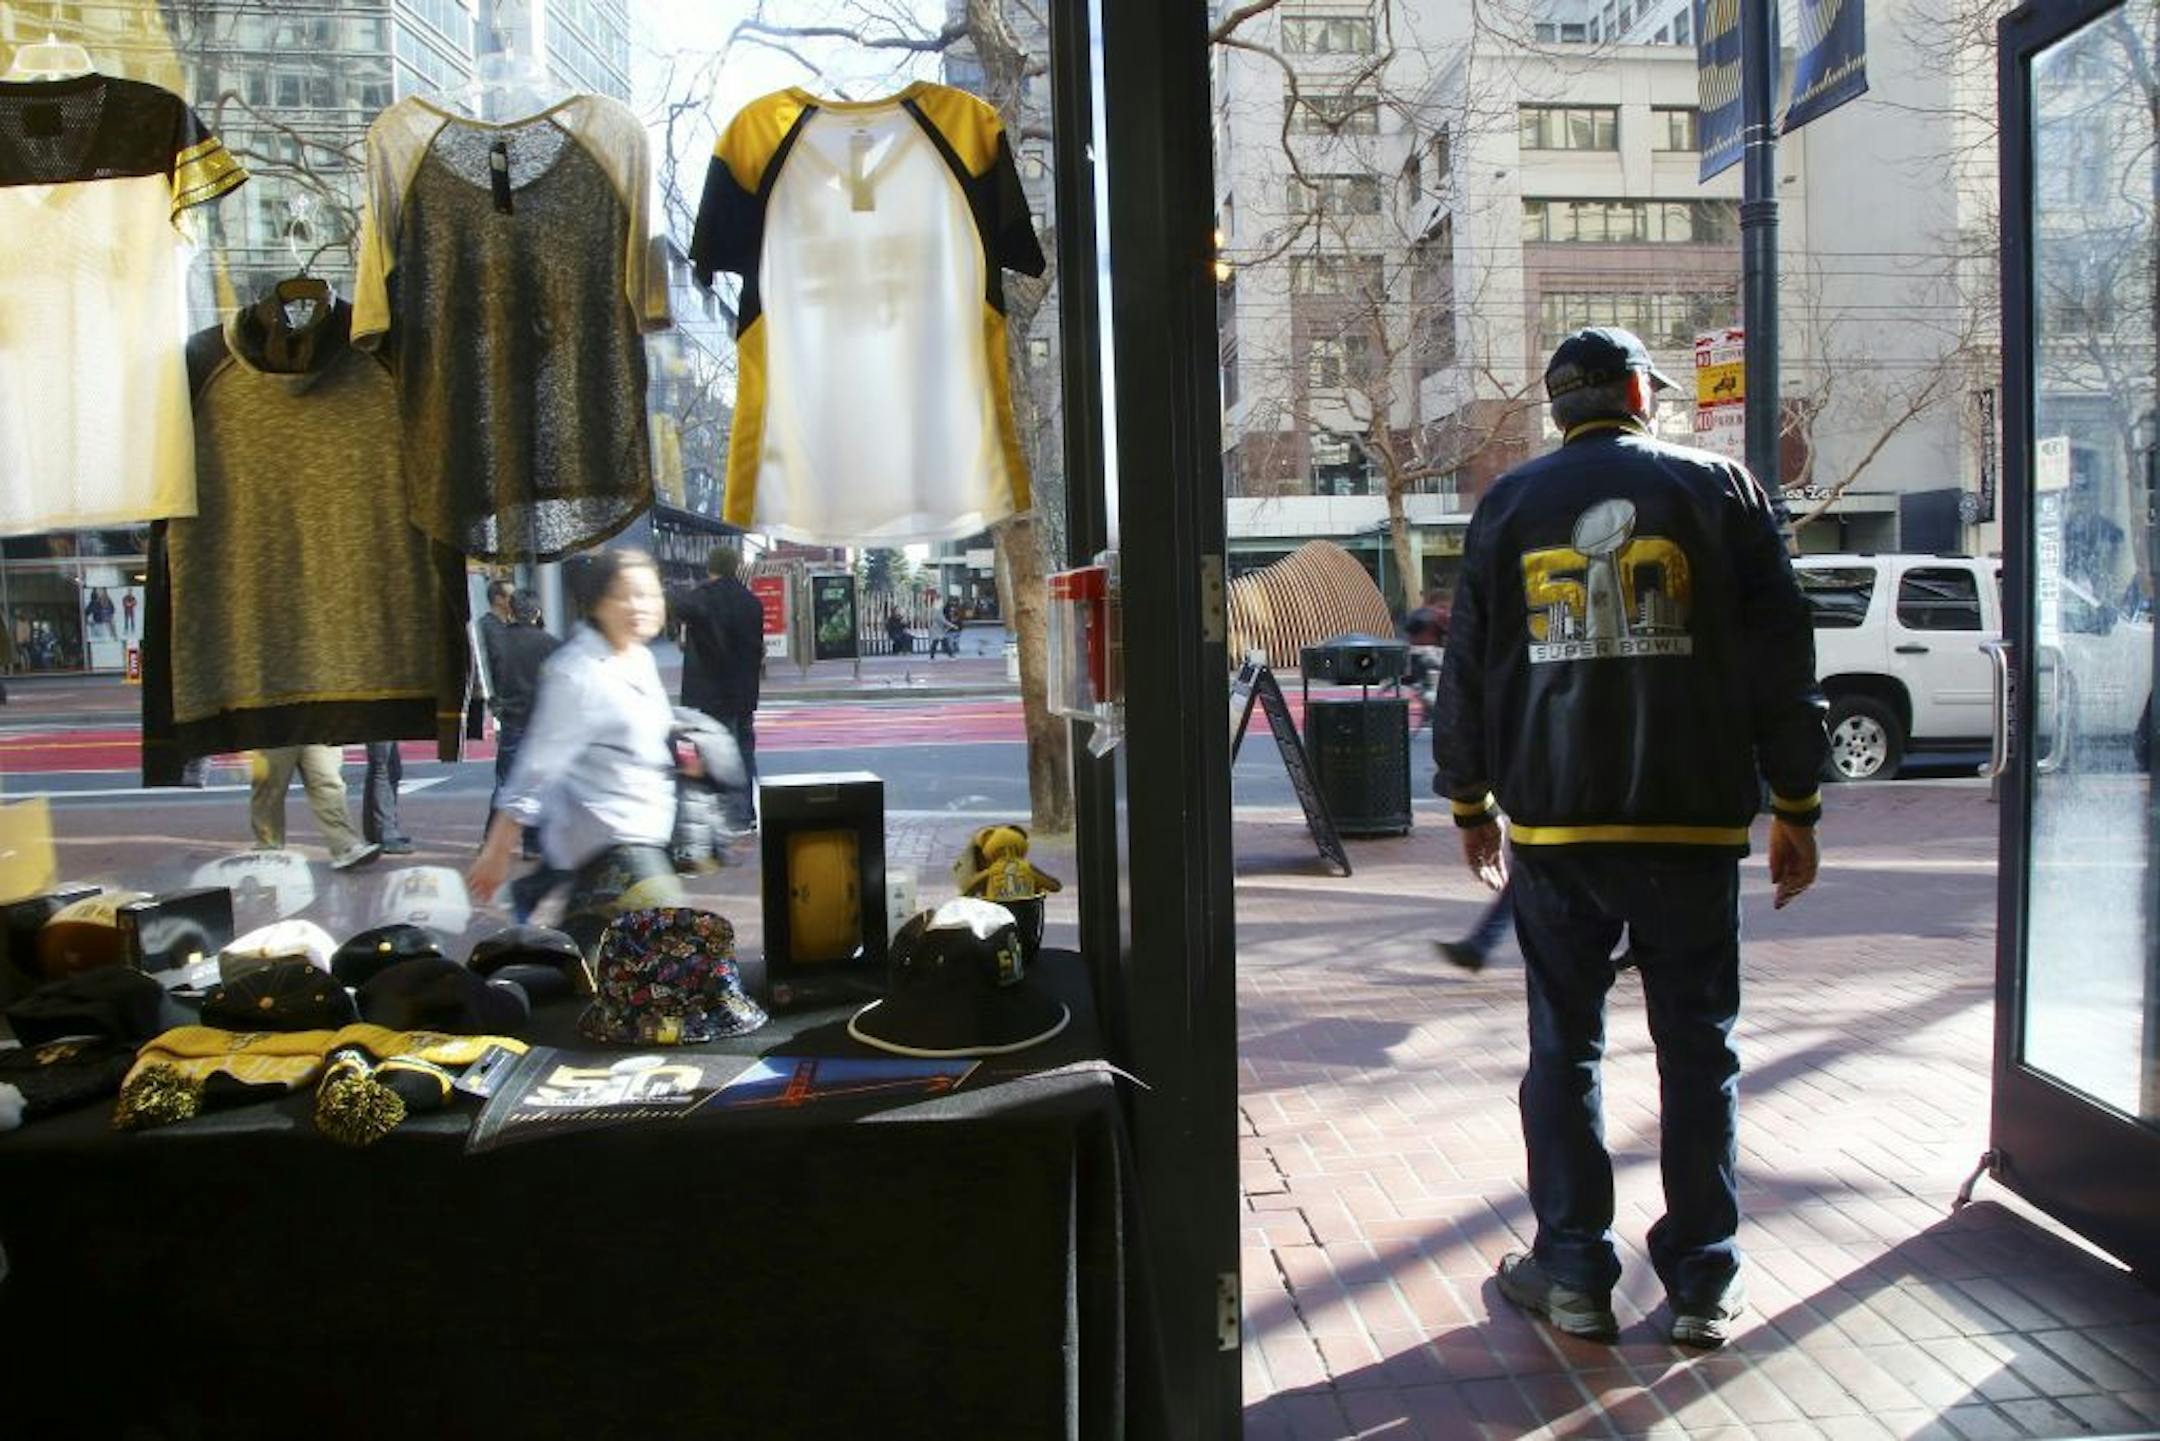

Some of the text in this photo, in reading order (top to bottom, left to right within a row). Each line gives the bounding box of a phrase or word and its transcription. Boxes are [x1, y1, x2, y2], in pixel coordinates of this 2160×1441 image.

[1521, 535, 1692, 641] 50
[1536, 638, 1686, 660] SUPER BOWL
